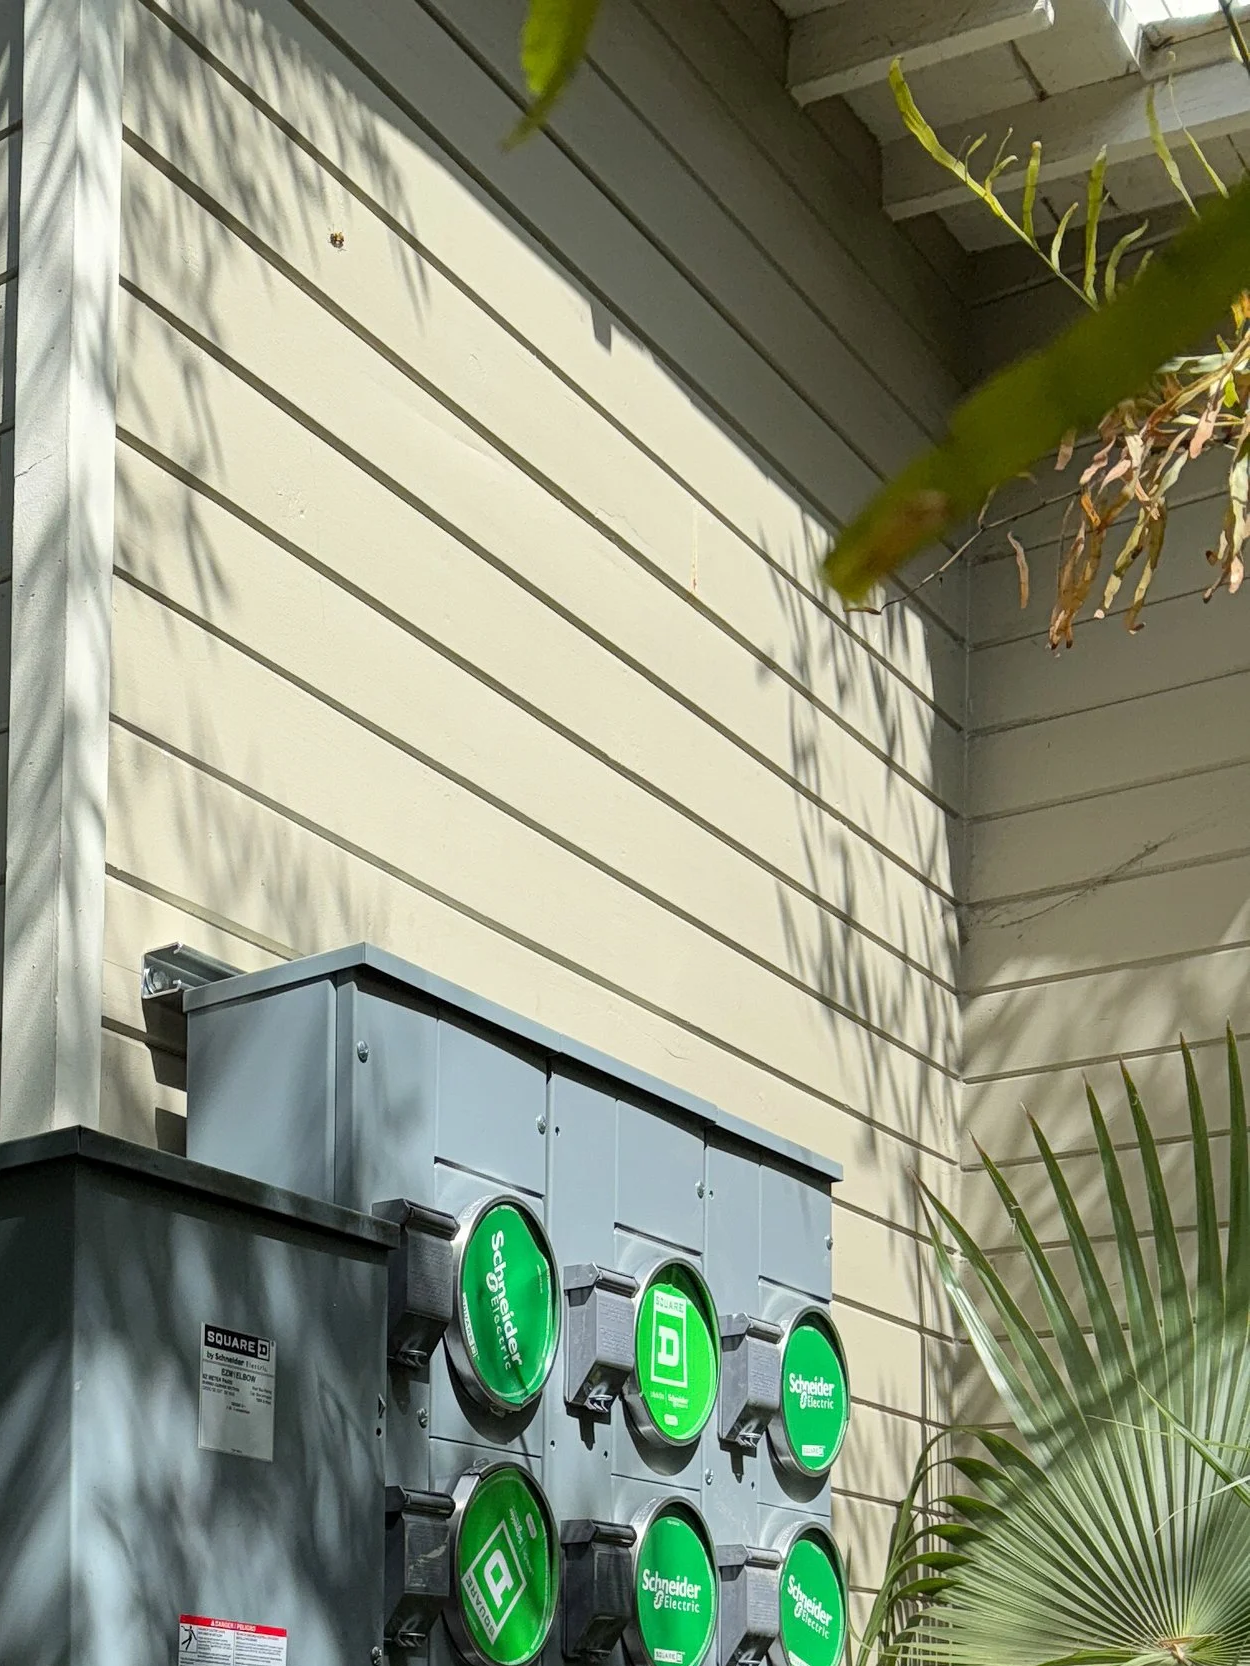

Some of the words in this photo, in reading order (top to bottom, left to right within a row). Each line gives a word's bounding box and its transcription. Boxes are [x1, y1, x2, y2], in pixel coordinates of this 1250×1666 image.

[491, 1230, 522, 1366] Schneider
[207, 1331, 256, 1353] SQUARE
[490, 1298, 511, 1371] Electric
[657, 1325, 680, 1367] D
[215, 1353, 244, 1366] Schneider
[789, 1373, 835, 1397] Schneider
[807, 1394, 834, 1410] Electric
[483, 1549, 514, 1610] D
[642, 1569, 702, 1599] Schneider
[466, 1574, 496, 1638] SQUARE
[664, 1595, 700, 1614] Electric
[787, 1575, 833, 1627] Schneider
[802, 1610, 830, 1640] Electric
